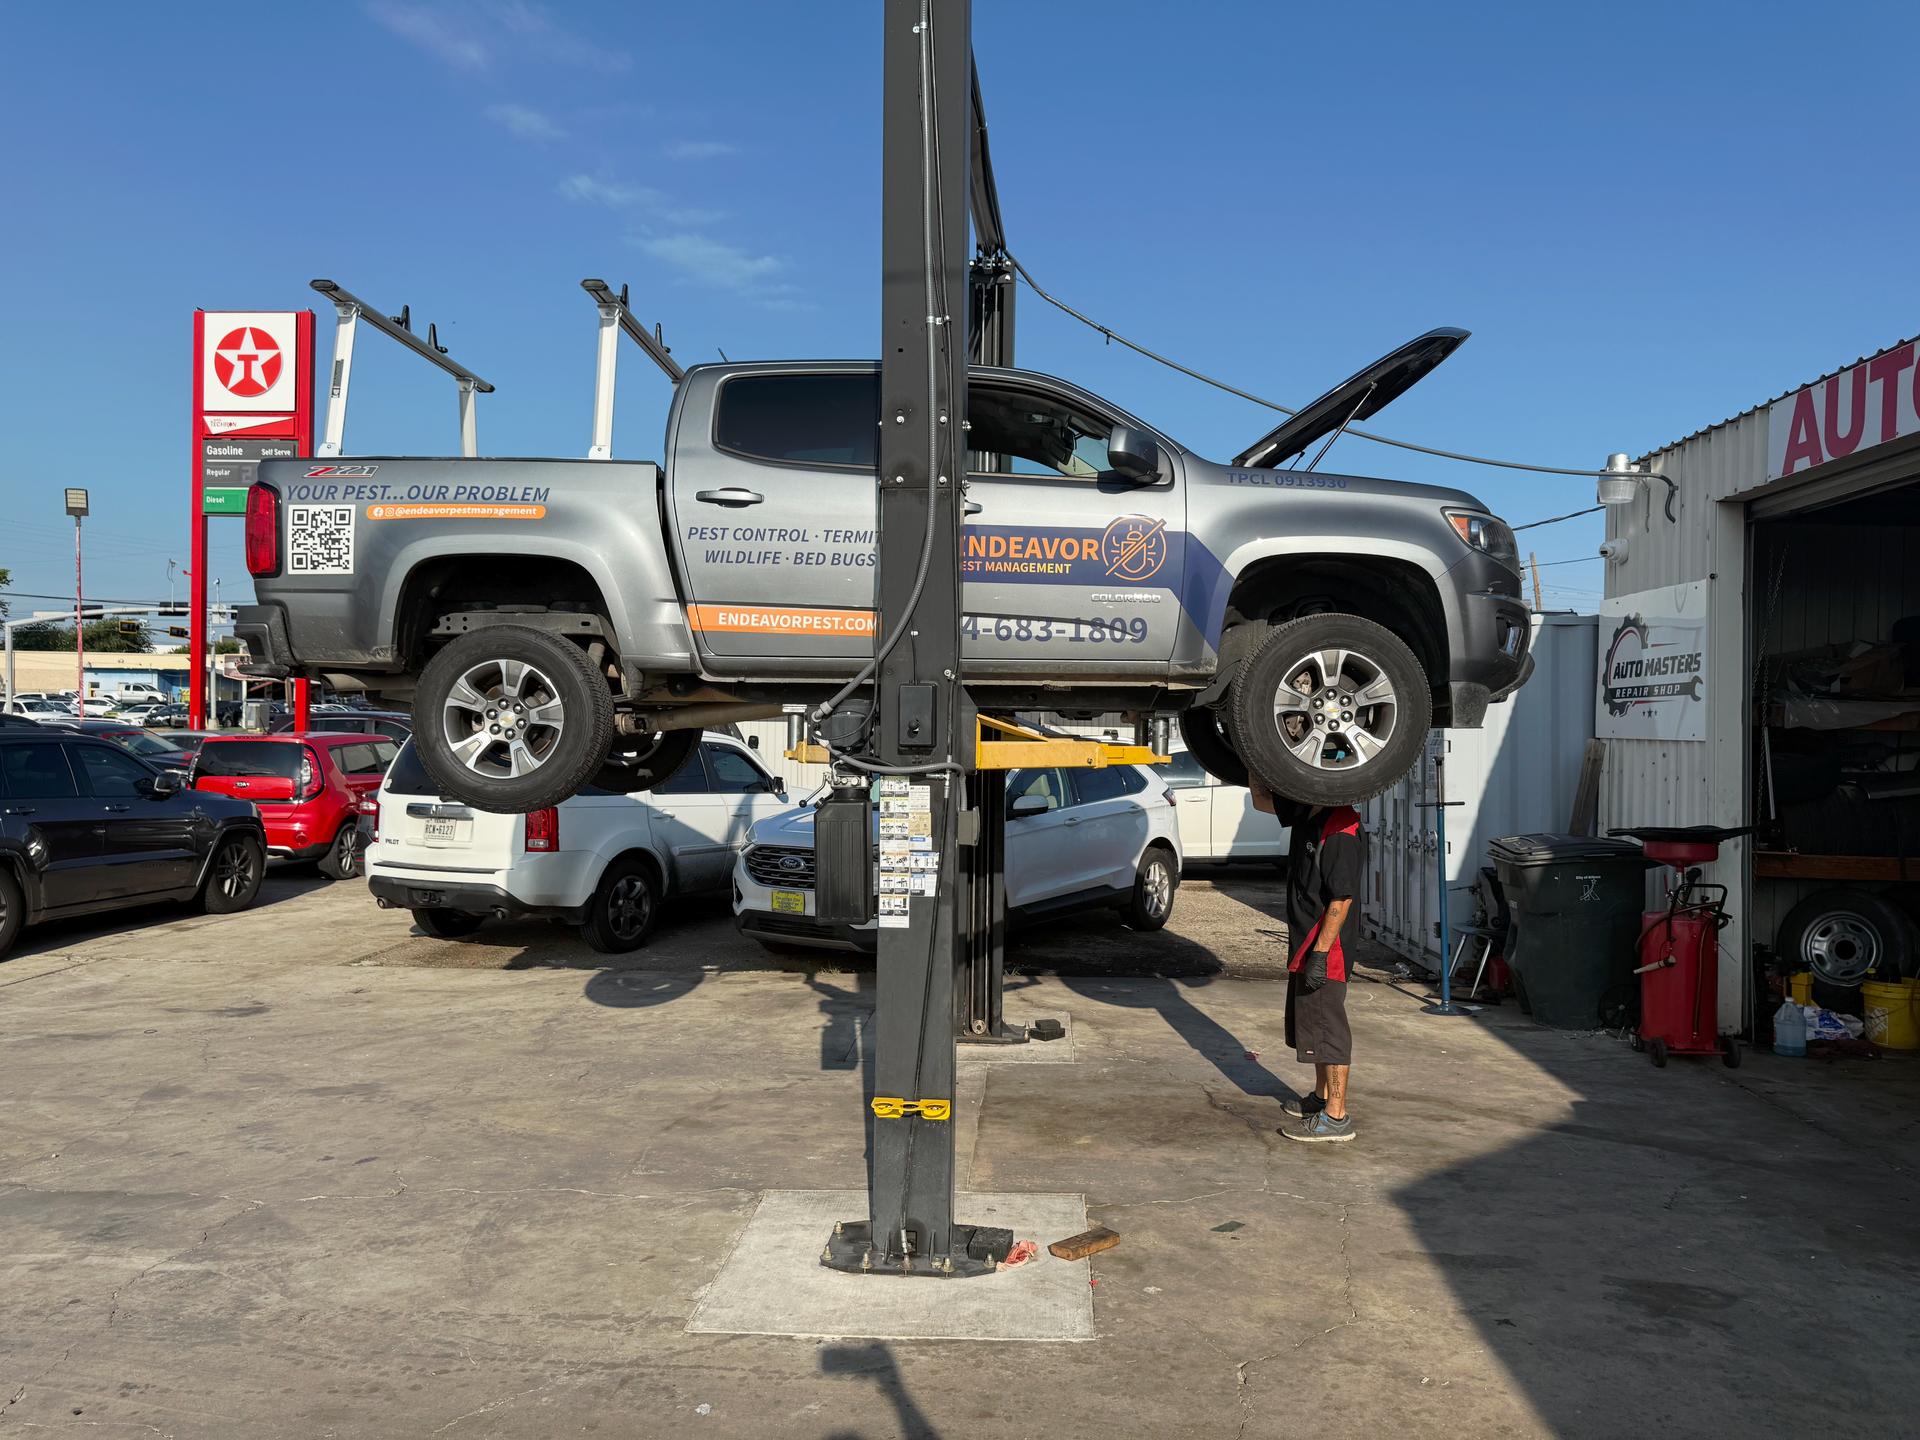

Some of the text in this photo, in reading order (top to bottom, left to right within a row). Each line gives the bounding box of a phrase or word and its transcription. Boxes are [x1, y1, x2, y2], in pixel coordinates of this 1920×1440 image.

[1782, 343, 1920, 476] AUT
[206, 445, 243, 456] Gasoline
[261, 448, 291, 456] Self Serve
[206, 468, 231, 477] Regular
[302, 465, 380, 478] Z71
[1227, 472, 1347, 489] TPCL 0913930
[206, 496, 225, 504] Diesel
[287, 485, 338, 501] YOUR
[453, 486, 550, 502] PROBLEM
[395, 506, 538, 518] @endeavorpestmanagement
[687, 526, 730, 541] PEST
[732, 527, 810, 543] CONTROL
[963, 535, 1100, 561] NDEAVOR
[705, 550, 877, 567] WILDLIFE BED BUGS
[985, 561, 1073, 574] MANAGEMENT
[1091, 592, 1162, 604] COLORADO
[1612, 652, 1702, 680] AUTO MASTERS
[1615, 684, 1681, 698] REPAIR SHOP
